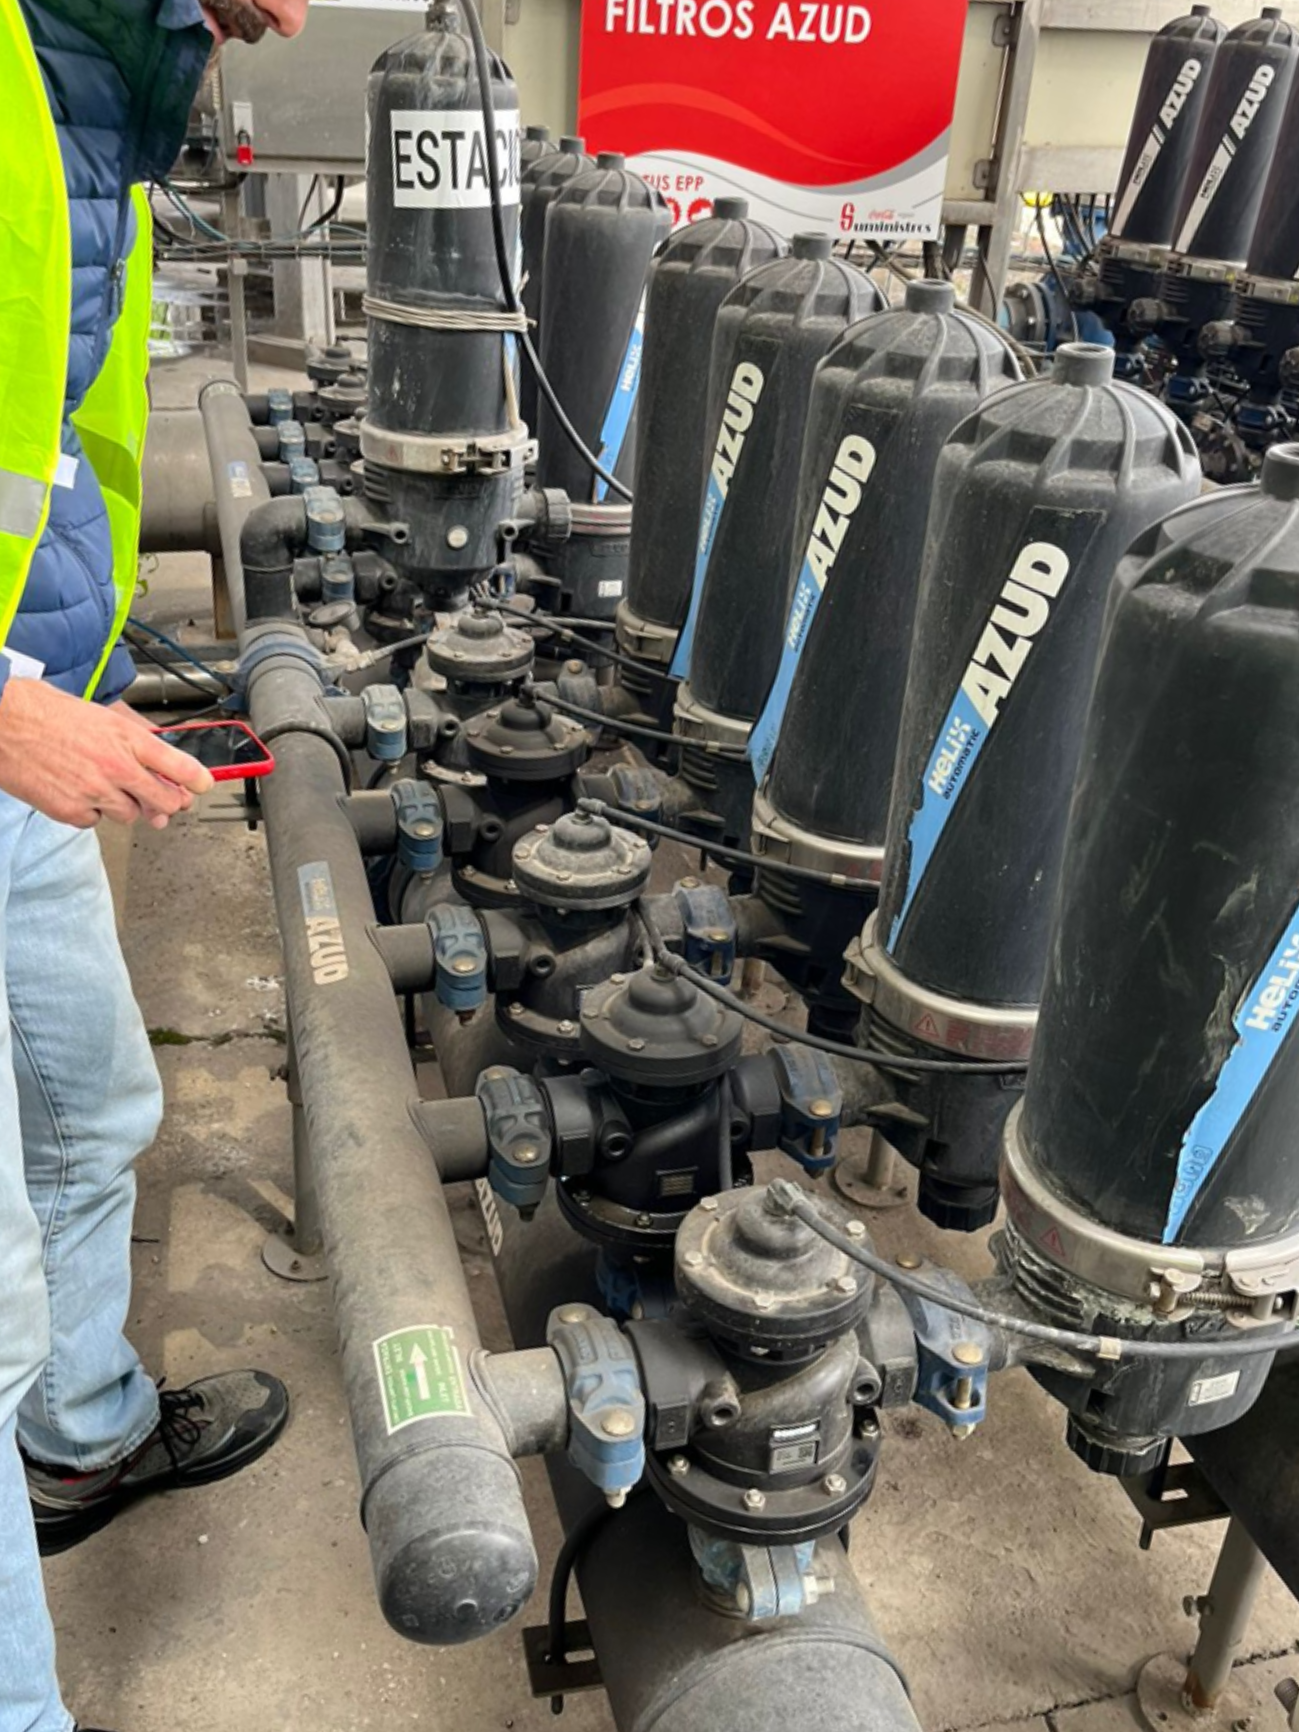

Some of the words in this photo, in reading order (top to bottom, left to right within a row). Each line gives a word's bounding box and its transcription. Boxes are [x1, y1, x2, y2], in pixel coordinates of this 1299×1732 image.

[605, 0, 754, 40] FILTROS
[766, 0, 872, 44] AZUD
[1159, 57, 1202, 130] AZUD
[1229, 63, 1275, 140] AZUD
[394, 129, 521, 190] ESTACI
[675, 175, 705, 192] EPP
[710, 360, 766, 499] AZUD
[806, 433, 877, 593] AZUD
[961, 540, 1070, 731] AZUD
[304, 916, 349, 986] AZUD
